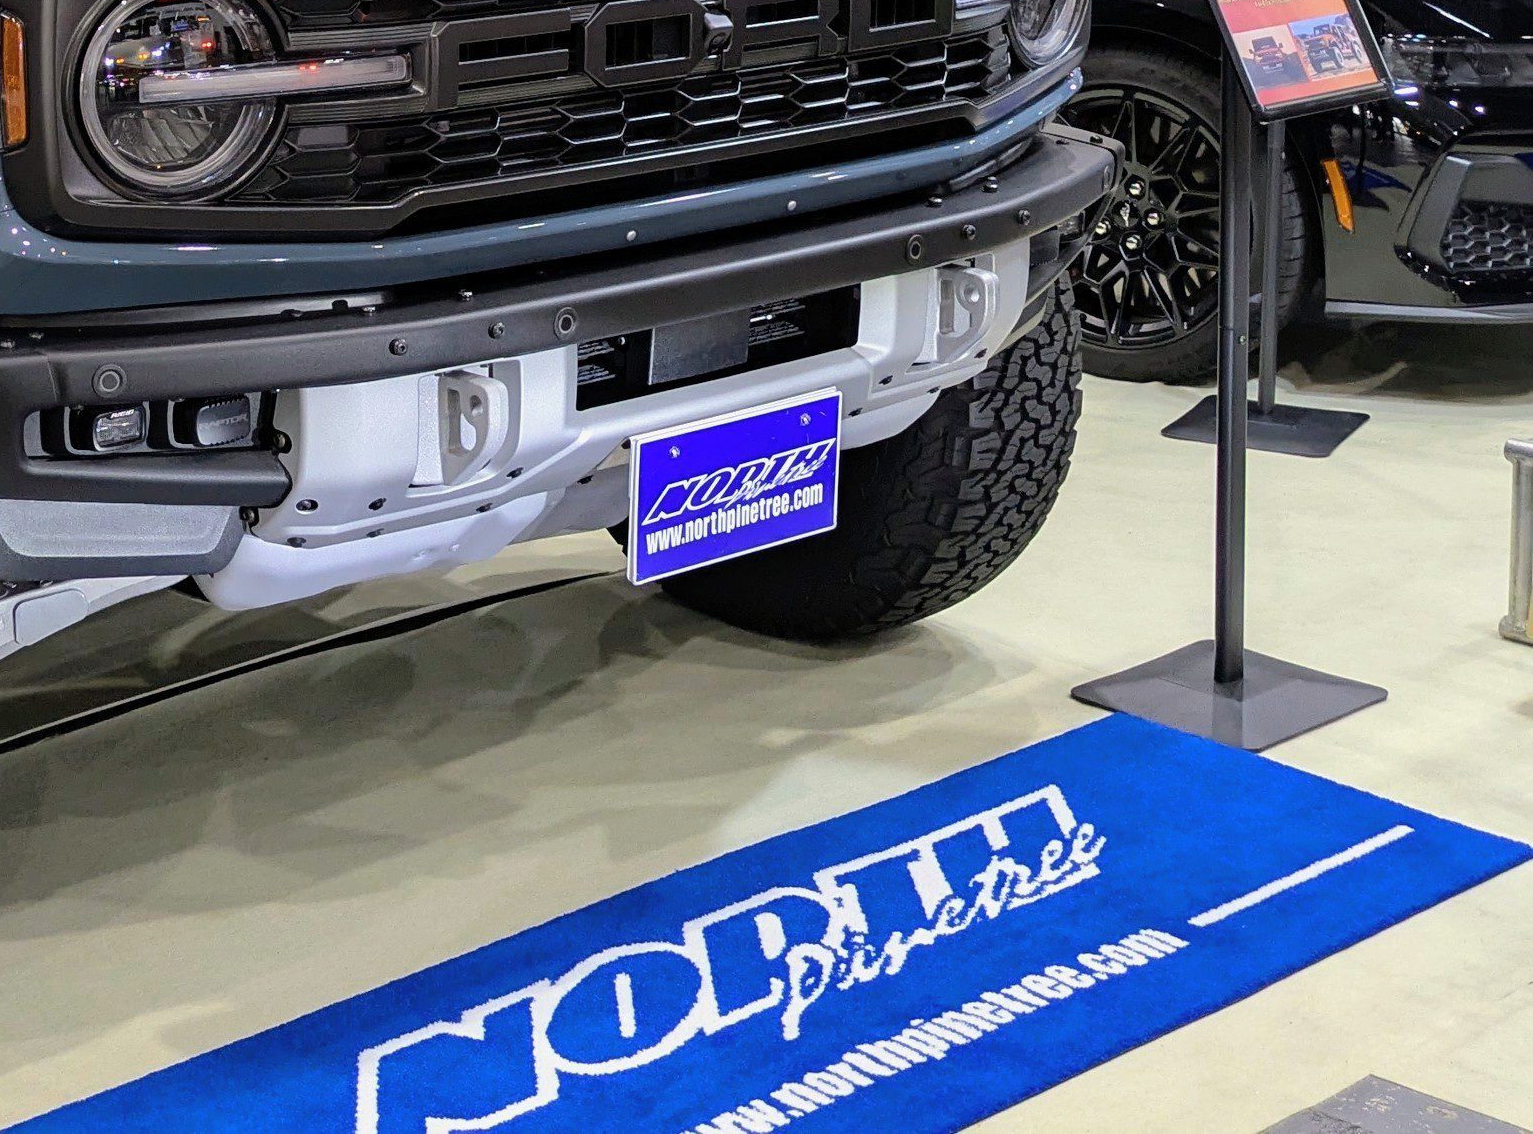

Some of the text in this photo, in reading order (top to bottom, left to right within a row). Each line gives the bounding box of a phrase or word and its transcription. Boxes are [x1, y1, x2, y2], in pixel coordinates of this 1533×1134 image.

[642, 438, 836, 526] NORTH
[646, 482, 823, 555] www.northpinetree.com
[355, 784, 1078, 1134] NORTH
